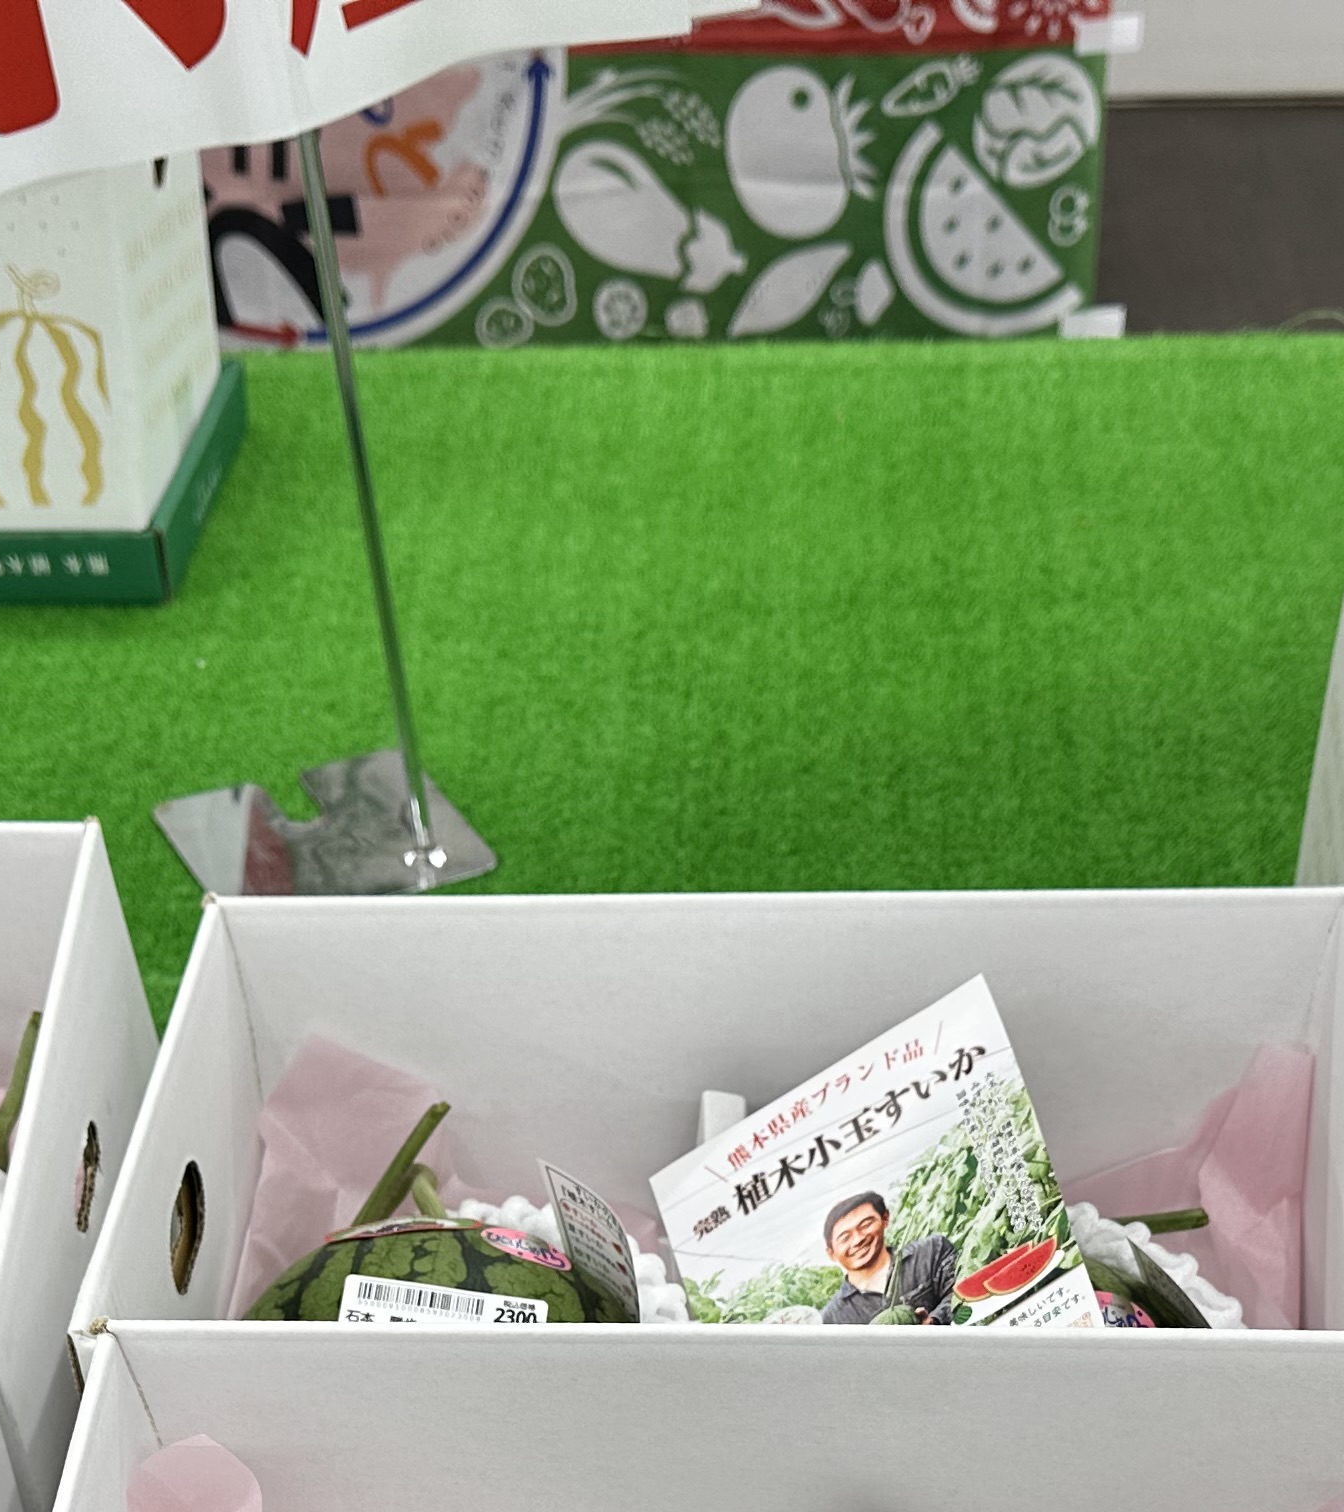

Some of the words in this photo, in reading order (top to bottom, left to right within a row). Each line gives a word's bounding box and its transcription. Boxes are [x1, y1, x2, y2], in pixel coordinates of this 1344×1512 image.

[727, 1038, 924, 1170] 熊本県産ブランド品
[732, 1045, 986, 1216] 植木小玉すいか
